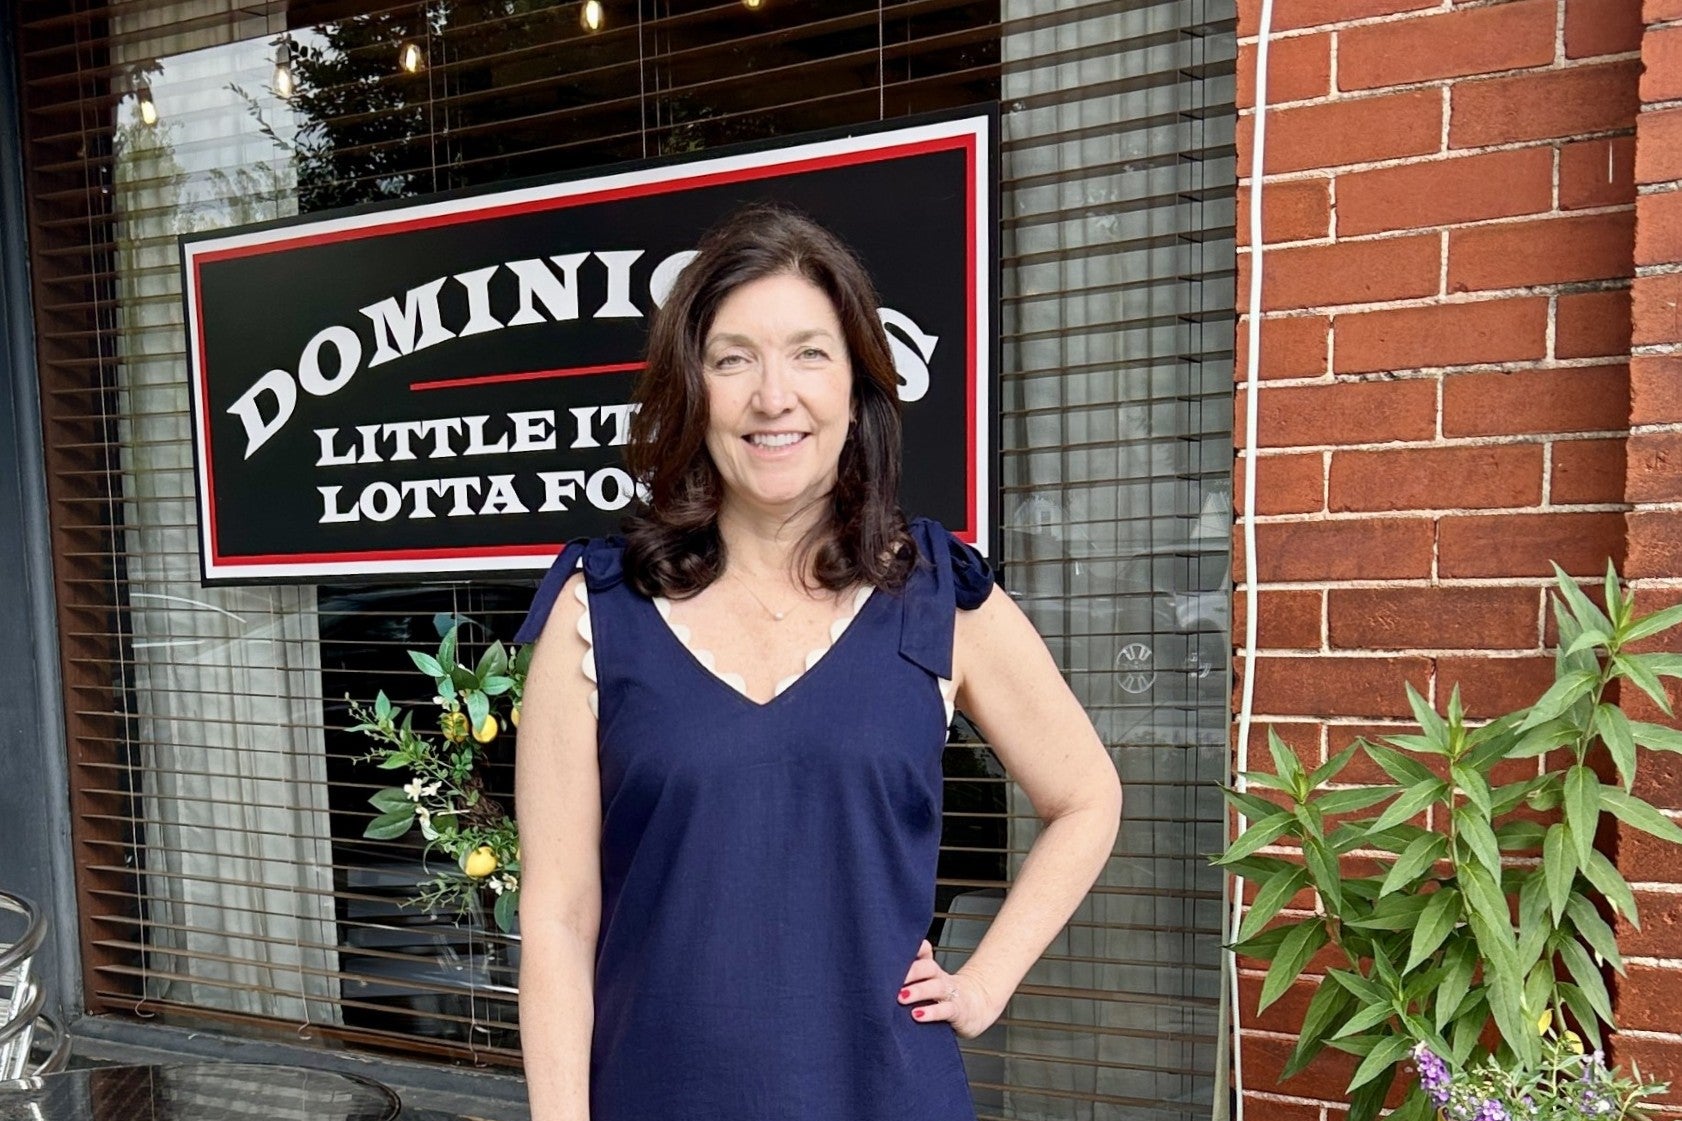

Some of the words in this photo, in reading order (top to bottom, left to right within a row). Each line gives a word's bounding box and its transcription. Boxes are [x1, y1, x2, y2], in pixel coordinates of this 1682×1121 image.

[313, 409, 557, 467] LITTLE
[568, 402, 648, 449] IT
[316, 475, 530, 524] LOTTA
[536, 466, 653, 513] FO
